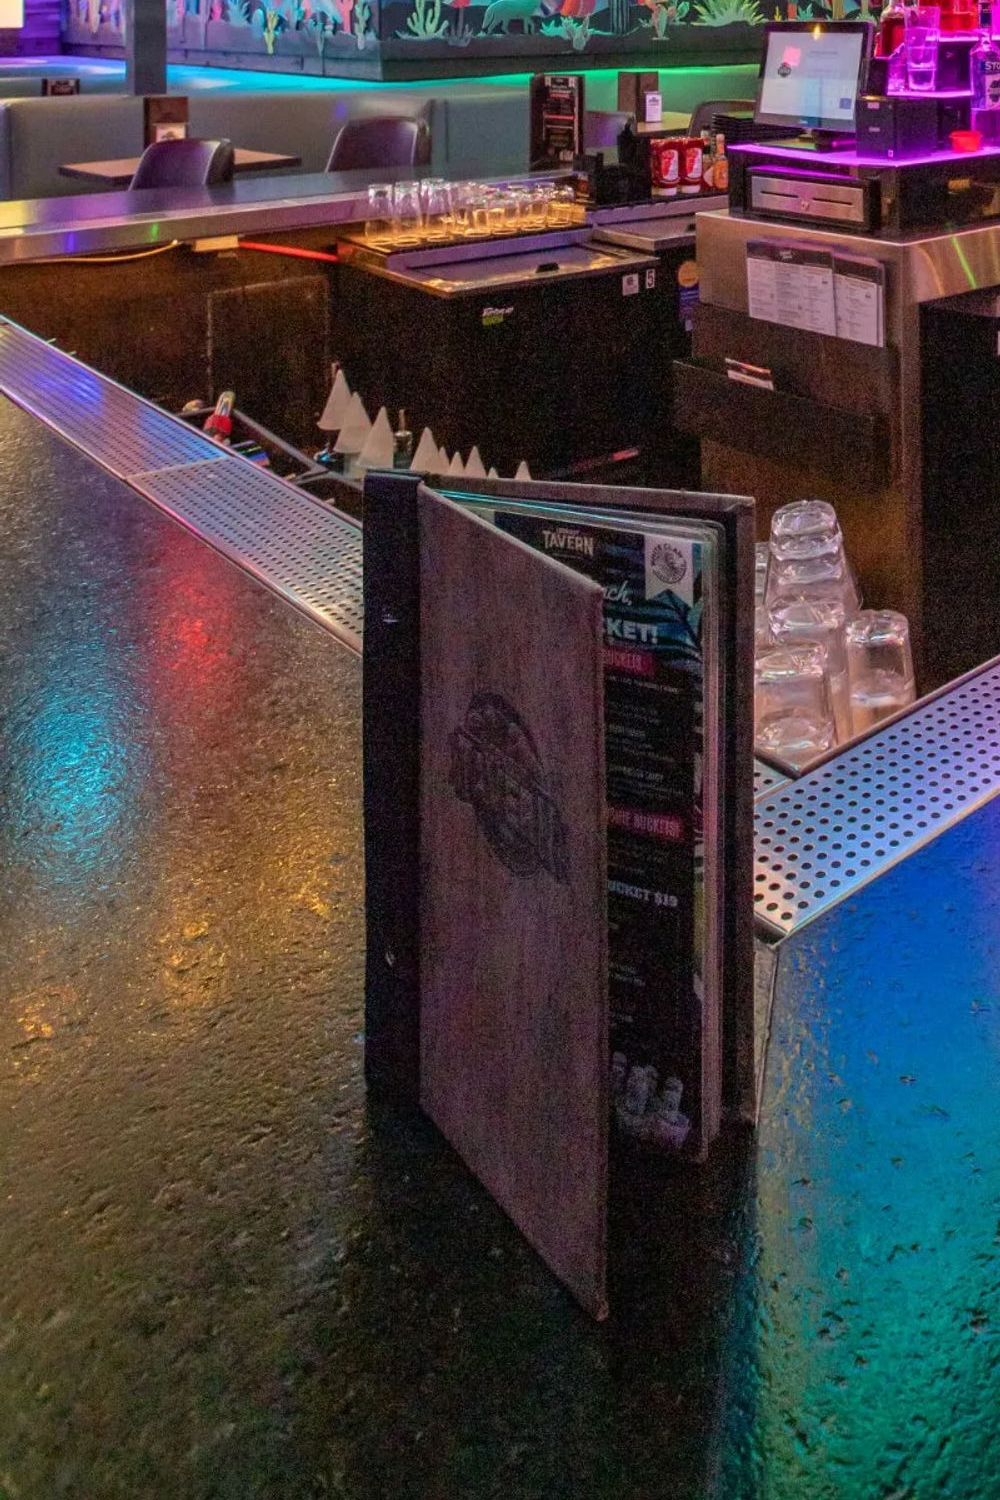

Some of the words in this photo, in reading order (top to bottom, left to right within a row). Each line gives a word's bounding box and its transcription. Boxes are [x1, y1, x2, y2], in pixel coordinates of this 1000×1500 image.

[647, 270, 654, 287] 5
[542, 529, 594, 558] TAVERN
[606, 617, 658, 644] KET!
